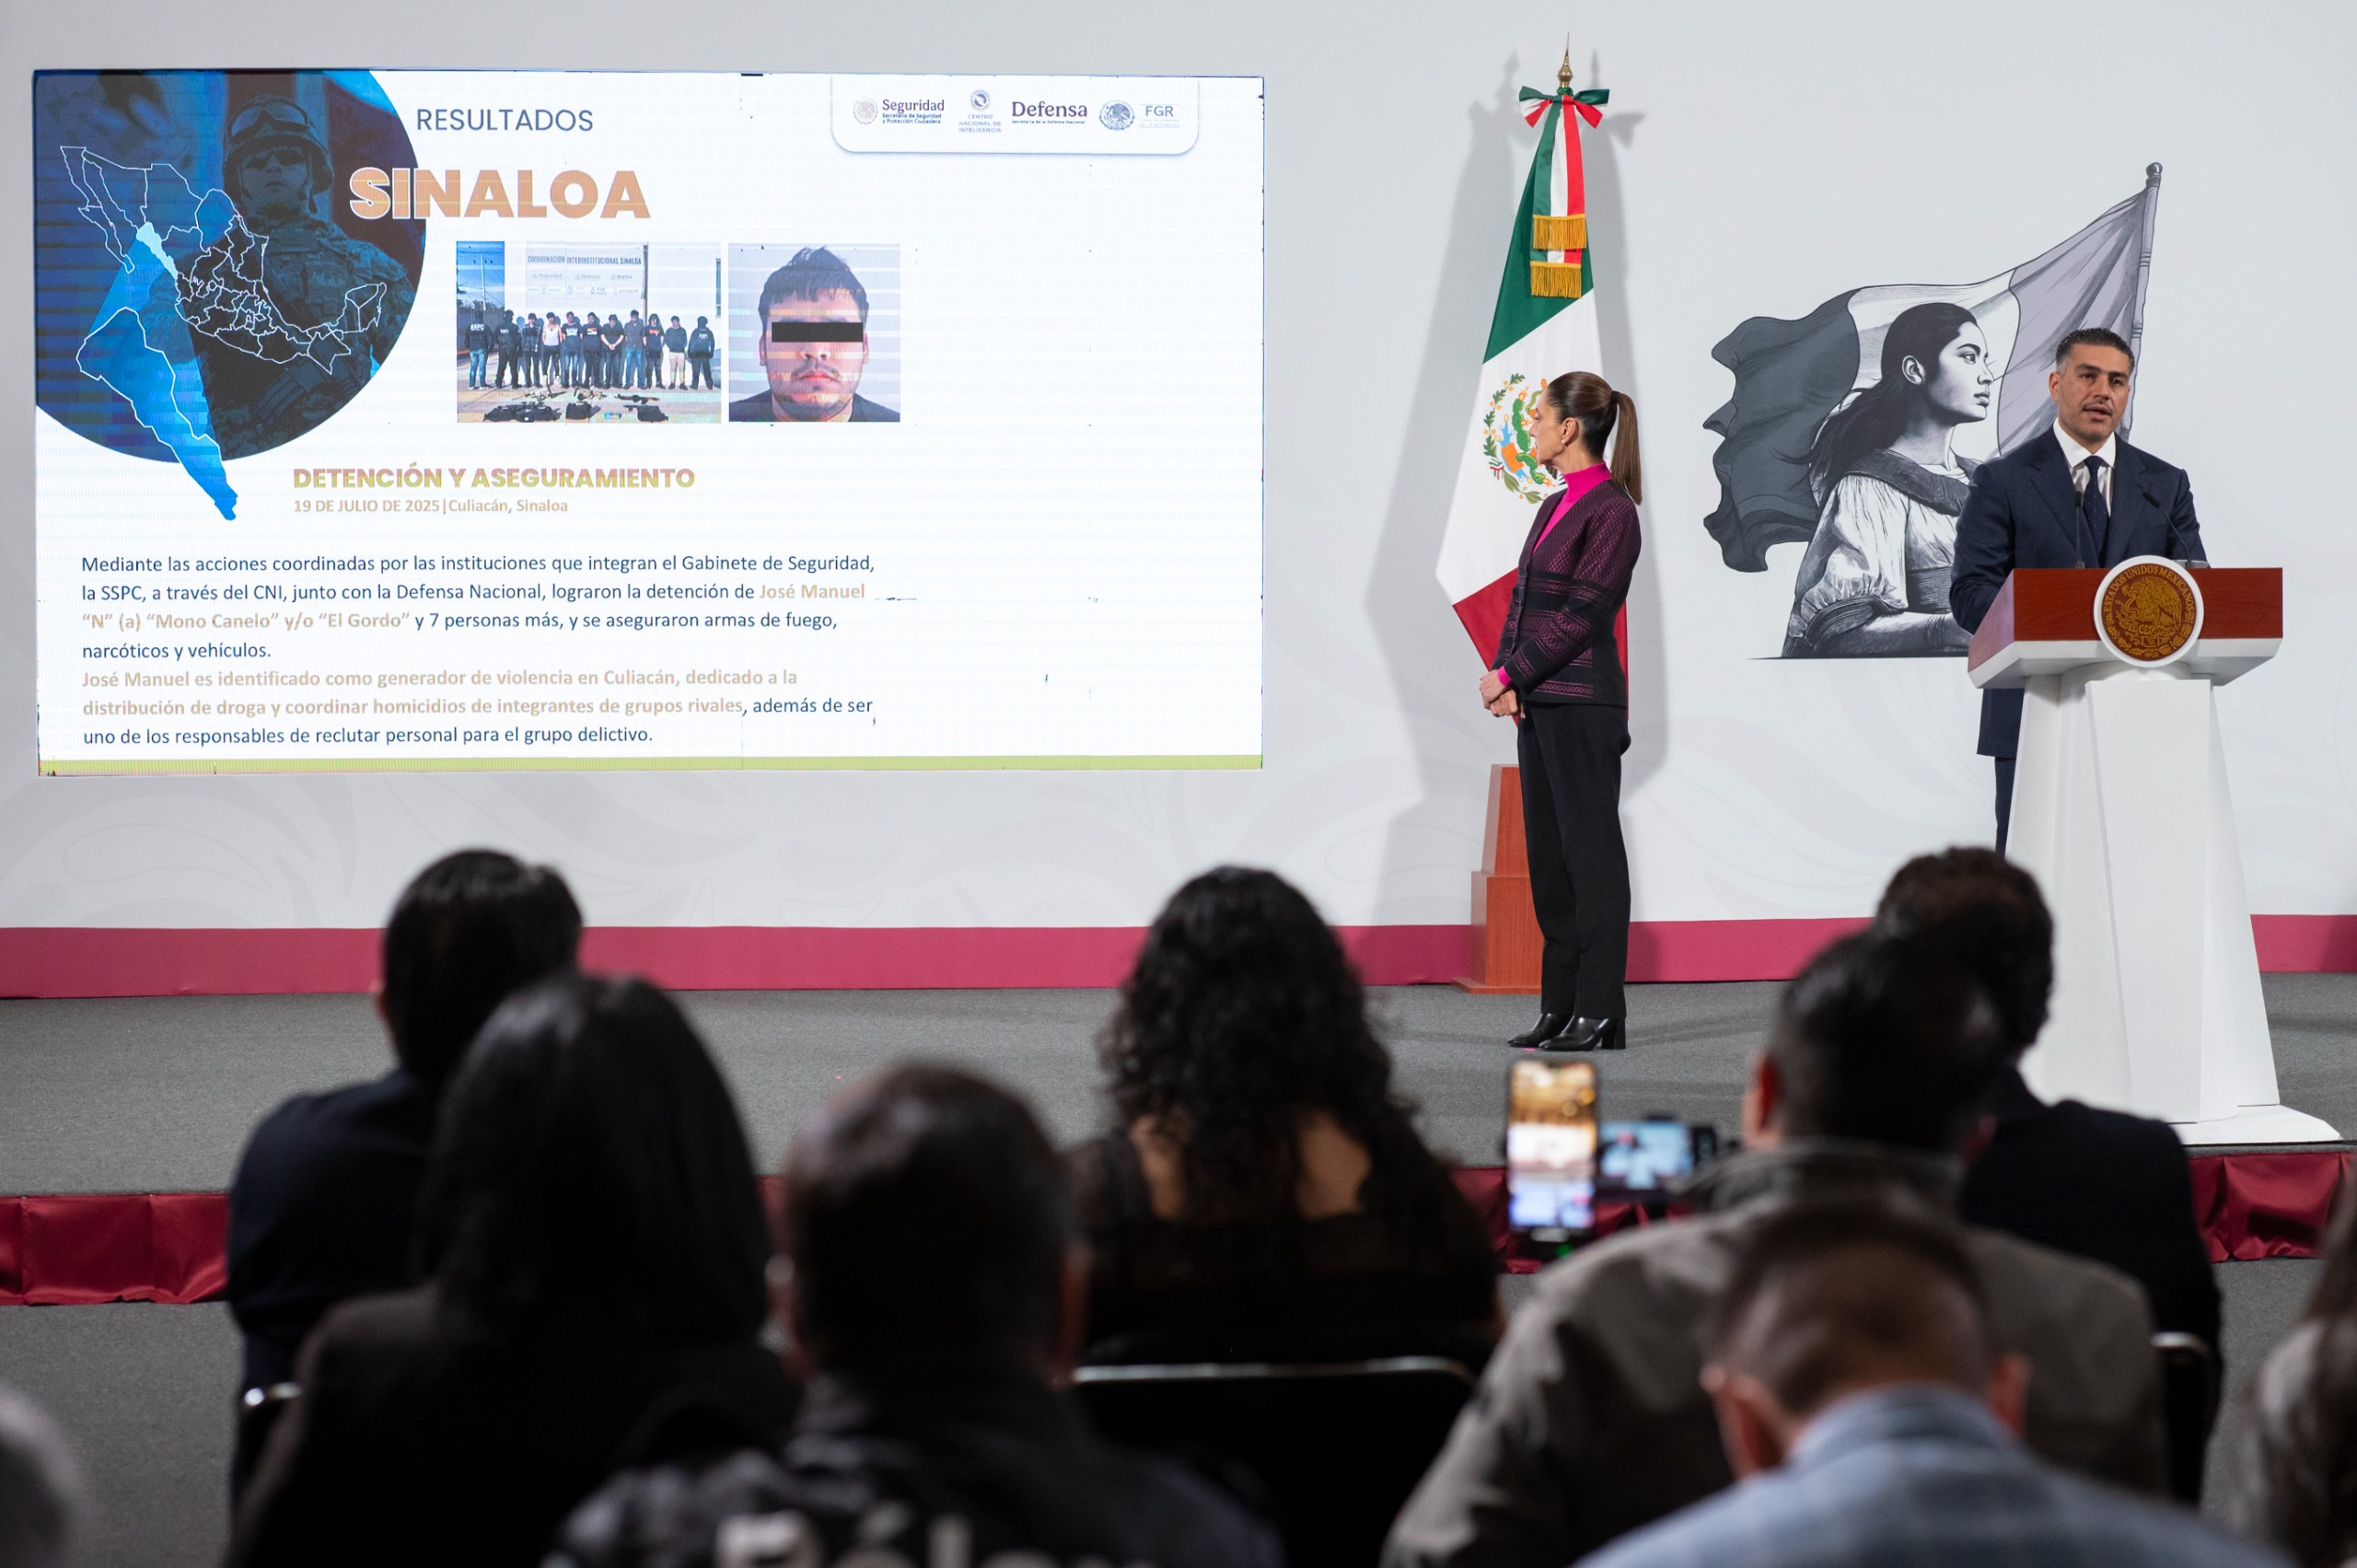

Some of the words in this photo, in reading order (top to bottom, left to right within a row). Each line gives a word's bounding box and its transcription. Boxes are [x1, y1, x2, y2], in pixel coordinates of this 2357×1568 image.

[882, 99, 945, 114] Seguridad
[1011, 100, 1087, 118] Defensa
[1145, 105, 1174, 117] FGR
[416, 108, 594, 133] RESULTADOS
[349, 166, 652, 220] SINALOA
[293, 461, 443, 489] DETENCIÓN
[447, 468, 467, 488] Y
[470, 468, 696, 489] ASEGURAMIENTO
[294, 499, 311, 514] 19
[315, 499, 334, 514] DE
[338, 499, 378, 514] JULIO
[382, 499, 401, 514] DE
[517, 498, 568, 513] Sinaloa
[81, 556, 163, 573] Mediante
[168, 555, 191, 572] las
[195, 556, 268, 572] acciones
[273, 554, 376, 572] coordinadas
[380, 559, 409, 575] por
[413, 553, 436, 571] las
[441, 555, 547, 571] instituciones
[552, 558, 583, 575] que
[588, 555, 657, 575] integran
[662, 554, 677, 571] el
[681, 554, 758, 571] Gabinete
[762, 554, 784, 571] de
[787, 554, 875, 575] Seguridad,
[82, 585, 96, 601] la
[100, 585, 147, 603] SSPC,
[152, 588, 161, 601] a
[166, 584, 218, 601] través
[223, 584, 249, 600] del
[253, 585, 287, 603] CNI,
[291, 584, 337, 604] junto
[341, 587, 372, 600] con
[377, 583, 391, 600] la
[397, 583, 464, 599] Defensa
[470, 582, 547, 602] Nacional,
[552, 582, 622, 603] lograron
[627, 583, 641, 599] la
[645, 582, 729, 599] detención
[734, 583, 755, 599] de
[759, 584, 795, 598] José
[801, 583, 865, 598] Manuel
[2103, 574, 2127, 613] ESTADOS
[2125, 564, 2159, 578] UNIDOS
[2158, 565, 2196, 611] MEXICANOS
[82, 613, 113, 629] “N”
[119, 612, 141, 633] (a)
[146, 613, 207, 630] “Mono
[211, 612, 279, 628] Canelo”
[284, 611, 314, 632] y/o
[319, 612, 343, 628] “El
[347, 611, 410, 628] Gordo”
[414, 616, 424, 632] y
[429, 612, 439, 628] 7
[444, 615, 520, 632] personas
[525, 610, 563, 631] más,
[568, 616, 579, 632] y
[582, 615, 601, 628] se
[606, 614, 700, 631] aseguraron
[703, 615, 756, 628] armas
[760, 611, 781, 628] de
[784, 610, 837, 632] fuego,
[82, 642, 169, 659] narcóticos
[173, 646, 184, 662] y
[187, 642, 272, 658] vehículos.
[82, 671, 119, 687] José
[124, 671, 190, 687] Manuel
[194, 675, 214, 687] es
[218, 670, 320, 686] identificado
[325, 674, 373, 686] como
[377, 669, 467, 688] generador
[470, 669, 493, 685] de
[496, 669, 574, 685] violencia
[577, 673, 598, 685] en
[603, 669, 680, 688] Culiacán,
[685, 669, 763, 685] dedicado
[768, 673, 778, 685] a
[783, 668, 797, 684] la
[83, 700, 185, 715] distribución
[190, 700, 212, 715] de
[216, 700, 266, 718] droga
[271, 703, 281, 718] y
[284, 699, 369, 714] coordinar
[373, 698, 467, 714] homicidios
[470, 698, 493, 714] de
[497, 698, 594, 716] integrantes
[599, 698, 621, 714] de
[624, 701, 683, 716] grupos
[688, 697, 748, 717] rivales,
[752, 696, 818, 714] además
[821, 696, 843, 714] de
[847, 701, 874, 713] ser
[83, 732, 116, 745] uno
[120, 728, 142, 745] de
[146, 727, 170, 744] los
[175, 726, 285, 748] responsables
[289, 726, 310, 743] de
[316, 726, 381, 743] reclutar
[386, 726, 458, 746] personal
[462, 730, 500, 746] para
[504, 726, 519, 742] el
[524, 729, 574, 746] grupo
[577, 726, 653, 742] delictivo.
